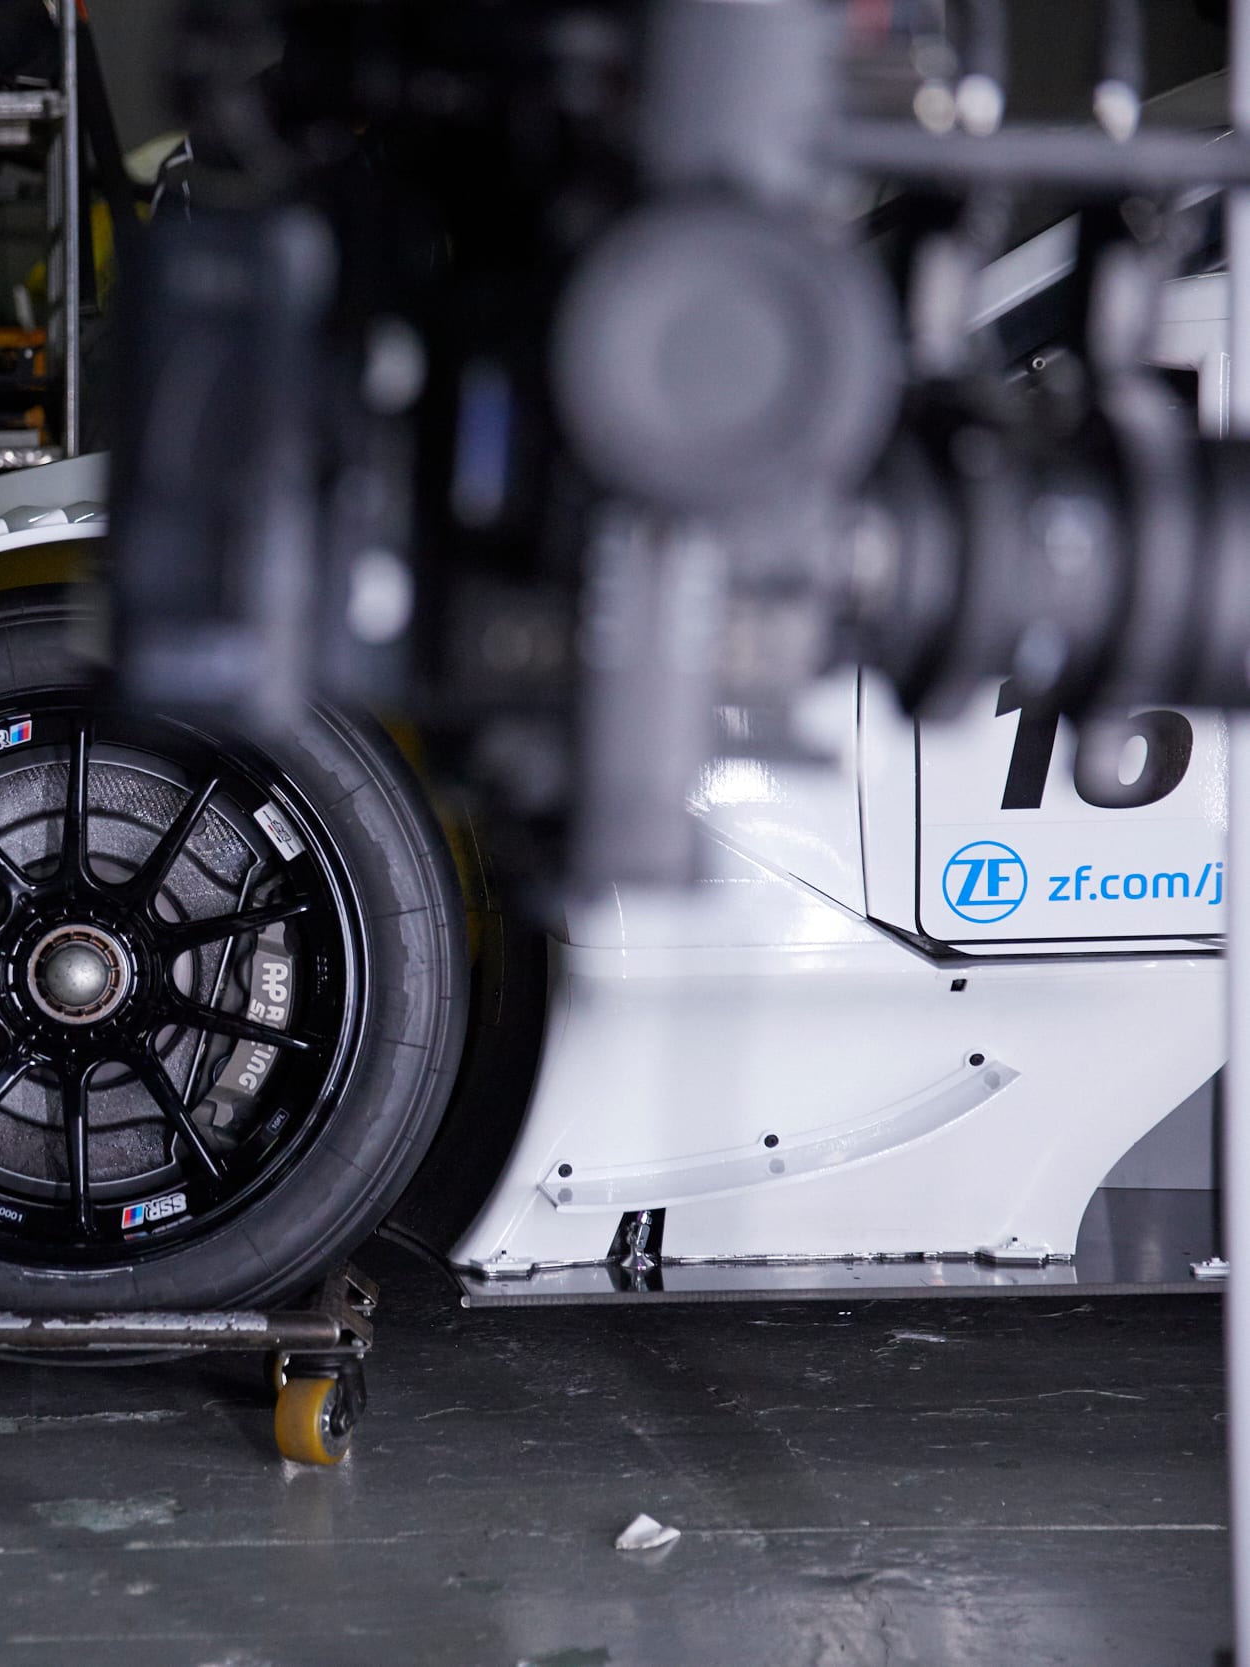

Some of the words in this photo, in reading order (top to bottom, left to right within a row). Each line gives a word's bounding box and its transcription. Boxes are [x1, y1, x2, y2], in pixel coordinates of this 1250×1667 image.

[995, 674, 1194, 811] 16
[949, 854, 1023, 908] ZF
[1048, 861, 1224, 906] zf.com/j
[261, 961, 290, 1004] AP
[238, 1005, 286, 1091] RING
[146, 1192, 188, 1222] SSR
